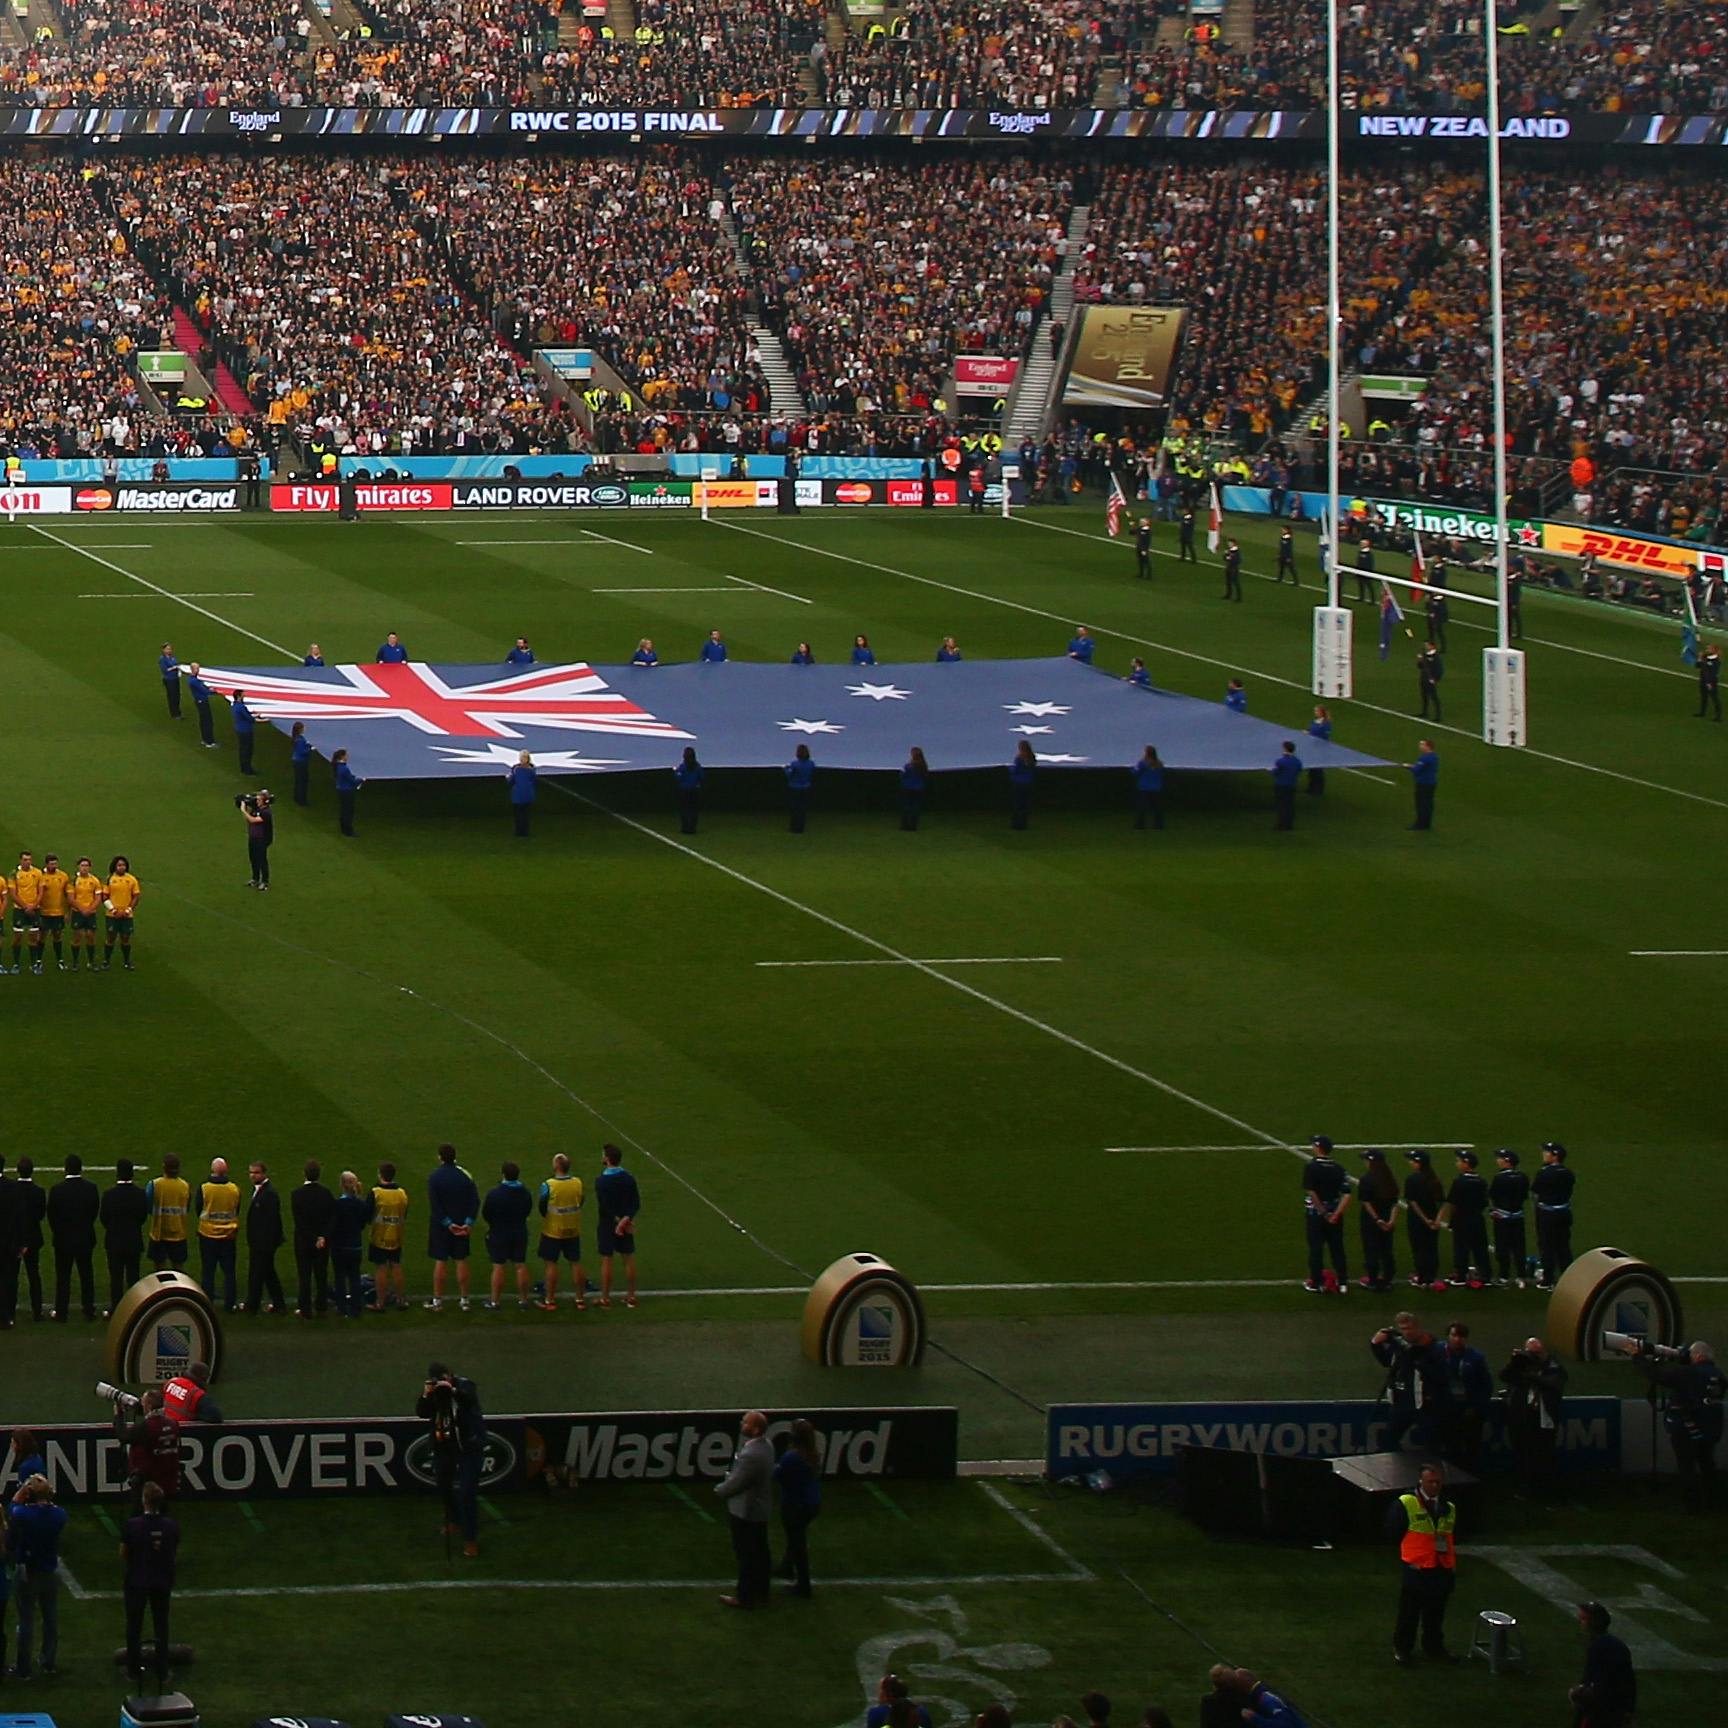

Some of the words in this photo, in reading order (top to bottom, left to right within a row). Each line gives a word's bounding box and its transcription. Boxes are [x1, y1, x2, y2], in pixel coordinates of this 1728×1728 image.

[229, 111, 280, 126] England
[510, 112, 570, 130] RWC
[576, 112, 638, 130] 2015
[644, 112, 725, 130] FINAL
[989, 112, 1051, 127] England
[1359, 117, 1427, 136] NEW
[1430, 117, 1571, 138] ZEAAND
[968, 363, 1007, 374] England
[291, 487, 329, 509] Fly
[453, 487, 514, 505] LAND
[518, 487, 591, 505] ROVER
[630, 494, 691, 506] Heineken
[707, 488, 743, 497] DHL
[1580, 534, 1667, 567] DHL
[155, 1358, 189, 1366] RUGBY
[858, 1353, 890, 1361] 2015
[166, 1383, 189, 1400] FIRE
[178, 1433, 398, 1491] ROVER
